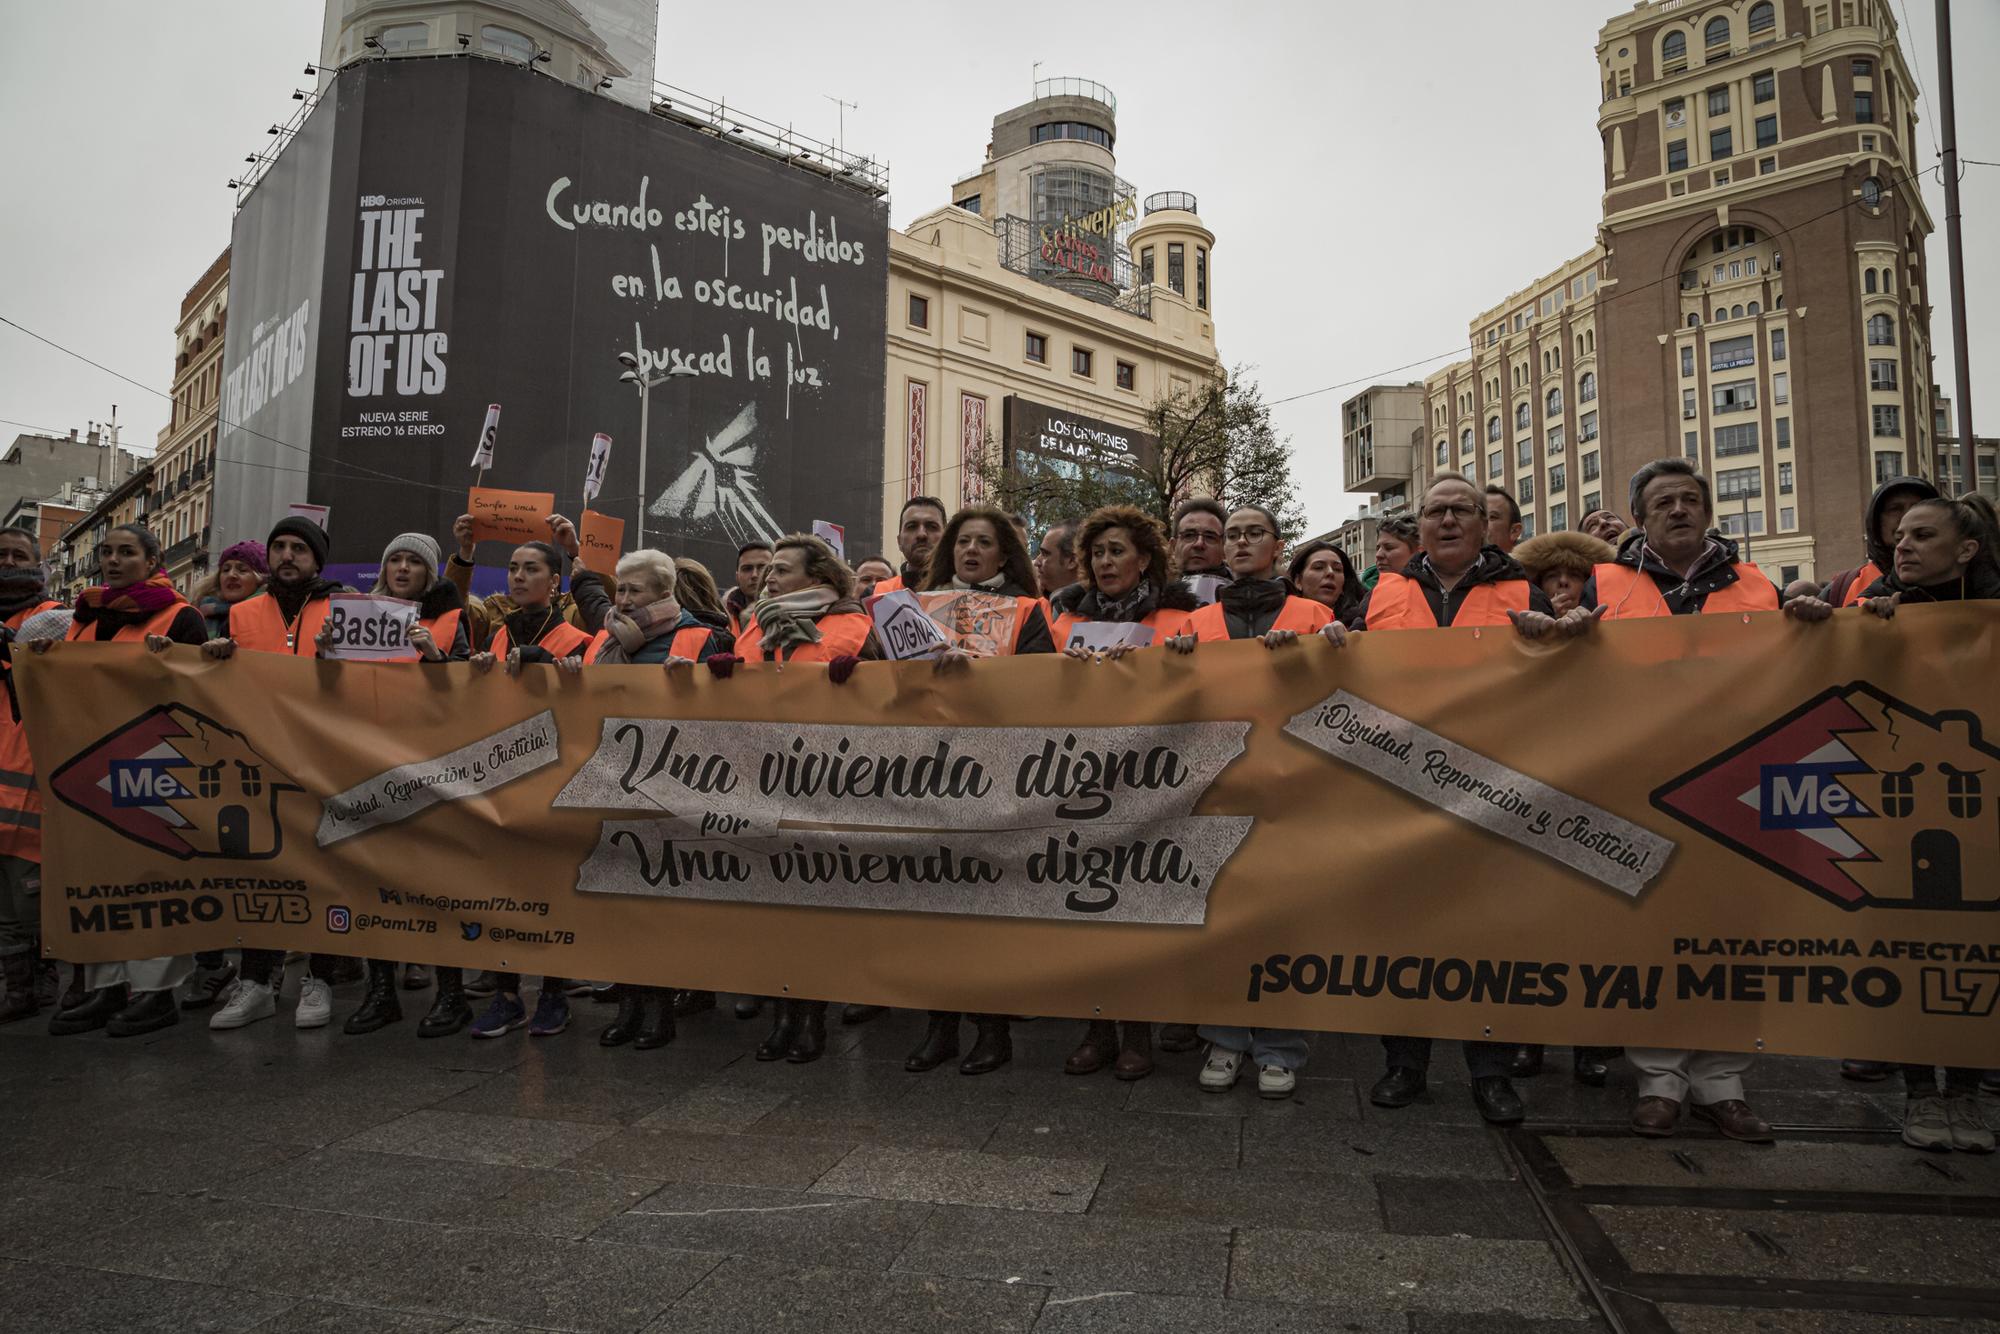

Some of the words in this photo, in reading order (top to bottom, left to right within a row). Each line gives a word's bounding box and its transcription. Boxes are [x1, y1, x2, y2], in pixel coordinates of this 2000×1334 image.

[360, 195, 386, 207] HBO
[386, 197, 424, 206] ORIGINAL
[360, 209, 424, 270] THE
[546, 176, 663, 231] Cuando
[675, 194, 745, 240] estéis
[762, 210, 865, 276] perdidos
[1055, 229, 1098, 260] CINES
[350, 270, 444, 332] LAST
[612, 274, 644, 298] en
[651, 243, 683, 301] la
[695, 276, 839, 340] oscuridad,
[242, 333, 275, 422] LAST
[287, 298, 309, 385] US
[348, 335, 394, 397] OF
[396, 332, 448, 396] US
[635, 321, 733, 377] buscad
[748, 327, 771, 381] la
[787, 342, 822, 386] luz
[341, 426, 392, 437] ESTRENO
[394, 426, 405, 436] 16
[407, 424, 445, 436] ENERO
[360, 412, 396, 423] NUEVA
[399, 411, 429, 421] SERIE
[1048, 418, 1070, 436] LOS
[1040, 434, 1057, 450] DE
[1059, 439, 1075, 455] LA
[333, 607, 414, 647] Basta!
[892, 617, 937, 653] DIGNA
[384, 767, 470, 802] Reparación
[473, 760, 486, 782] y
[488, 728, 550, 770] Justicia!
[614, 724, 739, 795] Una
[759, 735, 993, 799] vivienda
[1015, 733, 1189, 820] digna
[1314, 704, 1411, 765] ¡Dignidad,
[1422, 749, 1532, 819] Reparación
[1527, 806, 1552, 835] y
[1556, 814, 1650, 874] Justicia!
[700, 811, 751, 837] por
[65, 878, 195, 900] PLATAFORMA
[200, 878, 307, 891] AFECTADOS
[610, 830, 751, 887] Una
[769, 842, 1003, 885] vivienda
[1026, 830, 1201, 913] digna.
[69, 896, 224, 933] METRO
[232, 893, 312, 924] L7B
[355, 914, 437, 933] @PamL7B
[489, 927, 575, 945] @PamL7B
[1673, 938, 1862, 957] PLATAFORMA
[1247, 954, 1570, 1007] ¡SOLUCIONES
[1579, 963, 1663, 1010] YA!
[1676, 964, 1902, 1008] METRO
